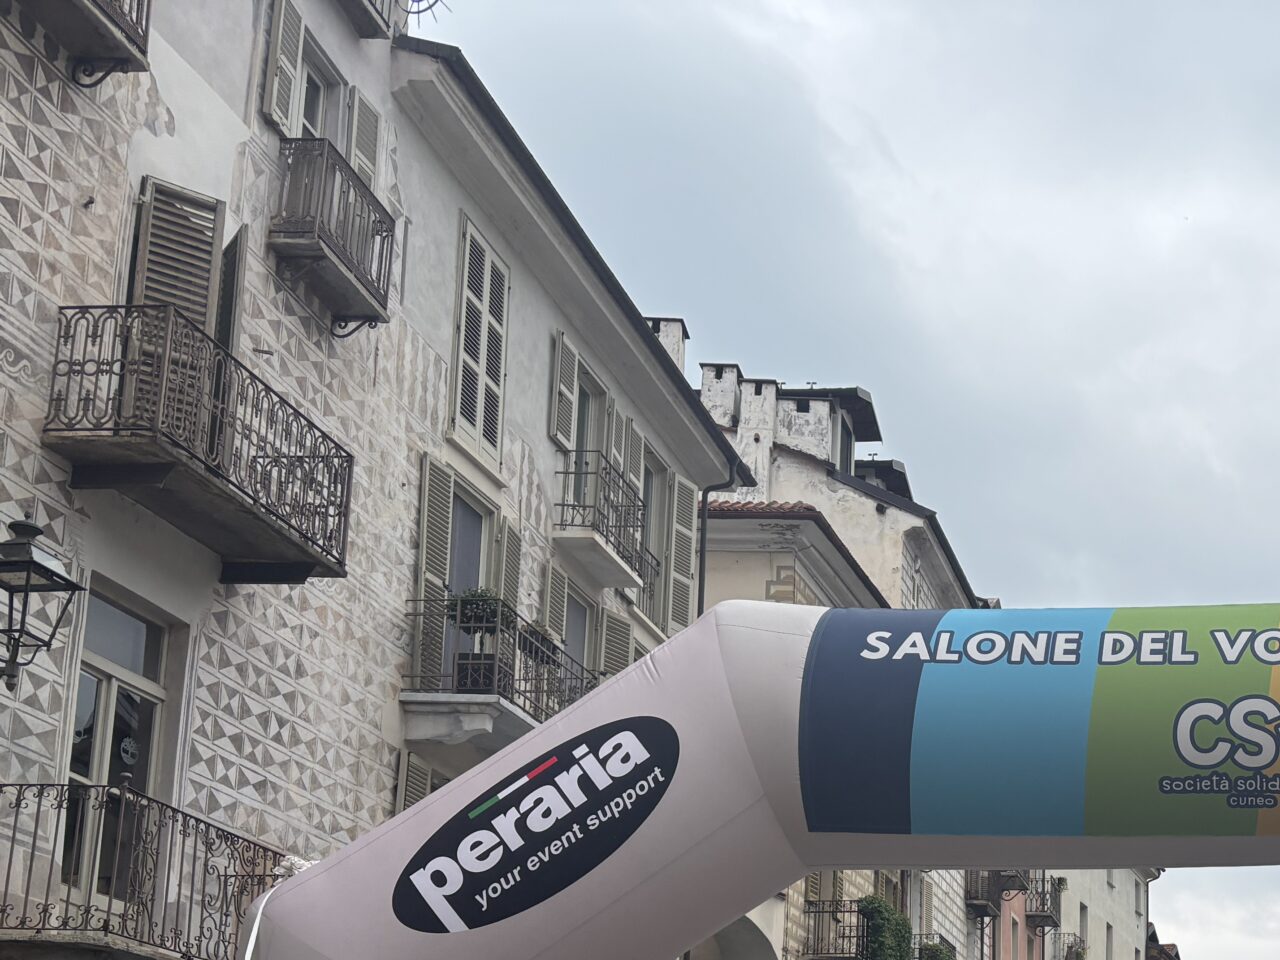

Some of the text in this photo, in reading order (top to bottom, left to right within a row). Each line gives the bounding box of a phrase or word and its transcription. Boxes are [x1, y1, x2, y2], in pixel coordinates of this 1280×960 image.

[858, 630, 1084, 665] SALONE
[1100, 630, 1197, 664] DEL
[1161, 773, 1230, 792] società
[1229, 795, 1275, 806] cuneo
[408, 729, 652, 935] peraria
[473, 765, 666, 912] your event support
